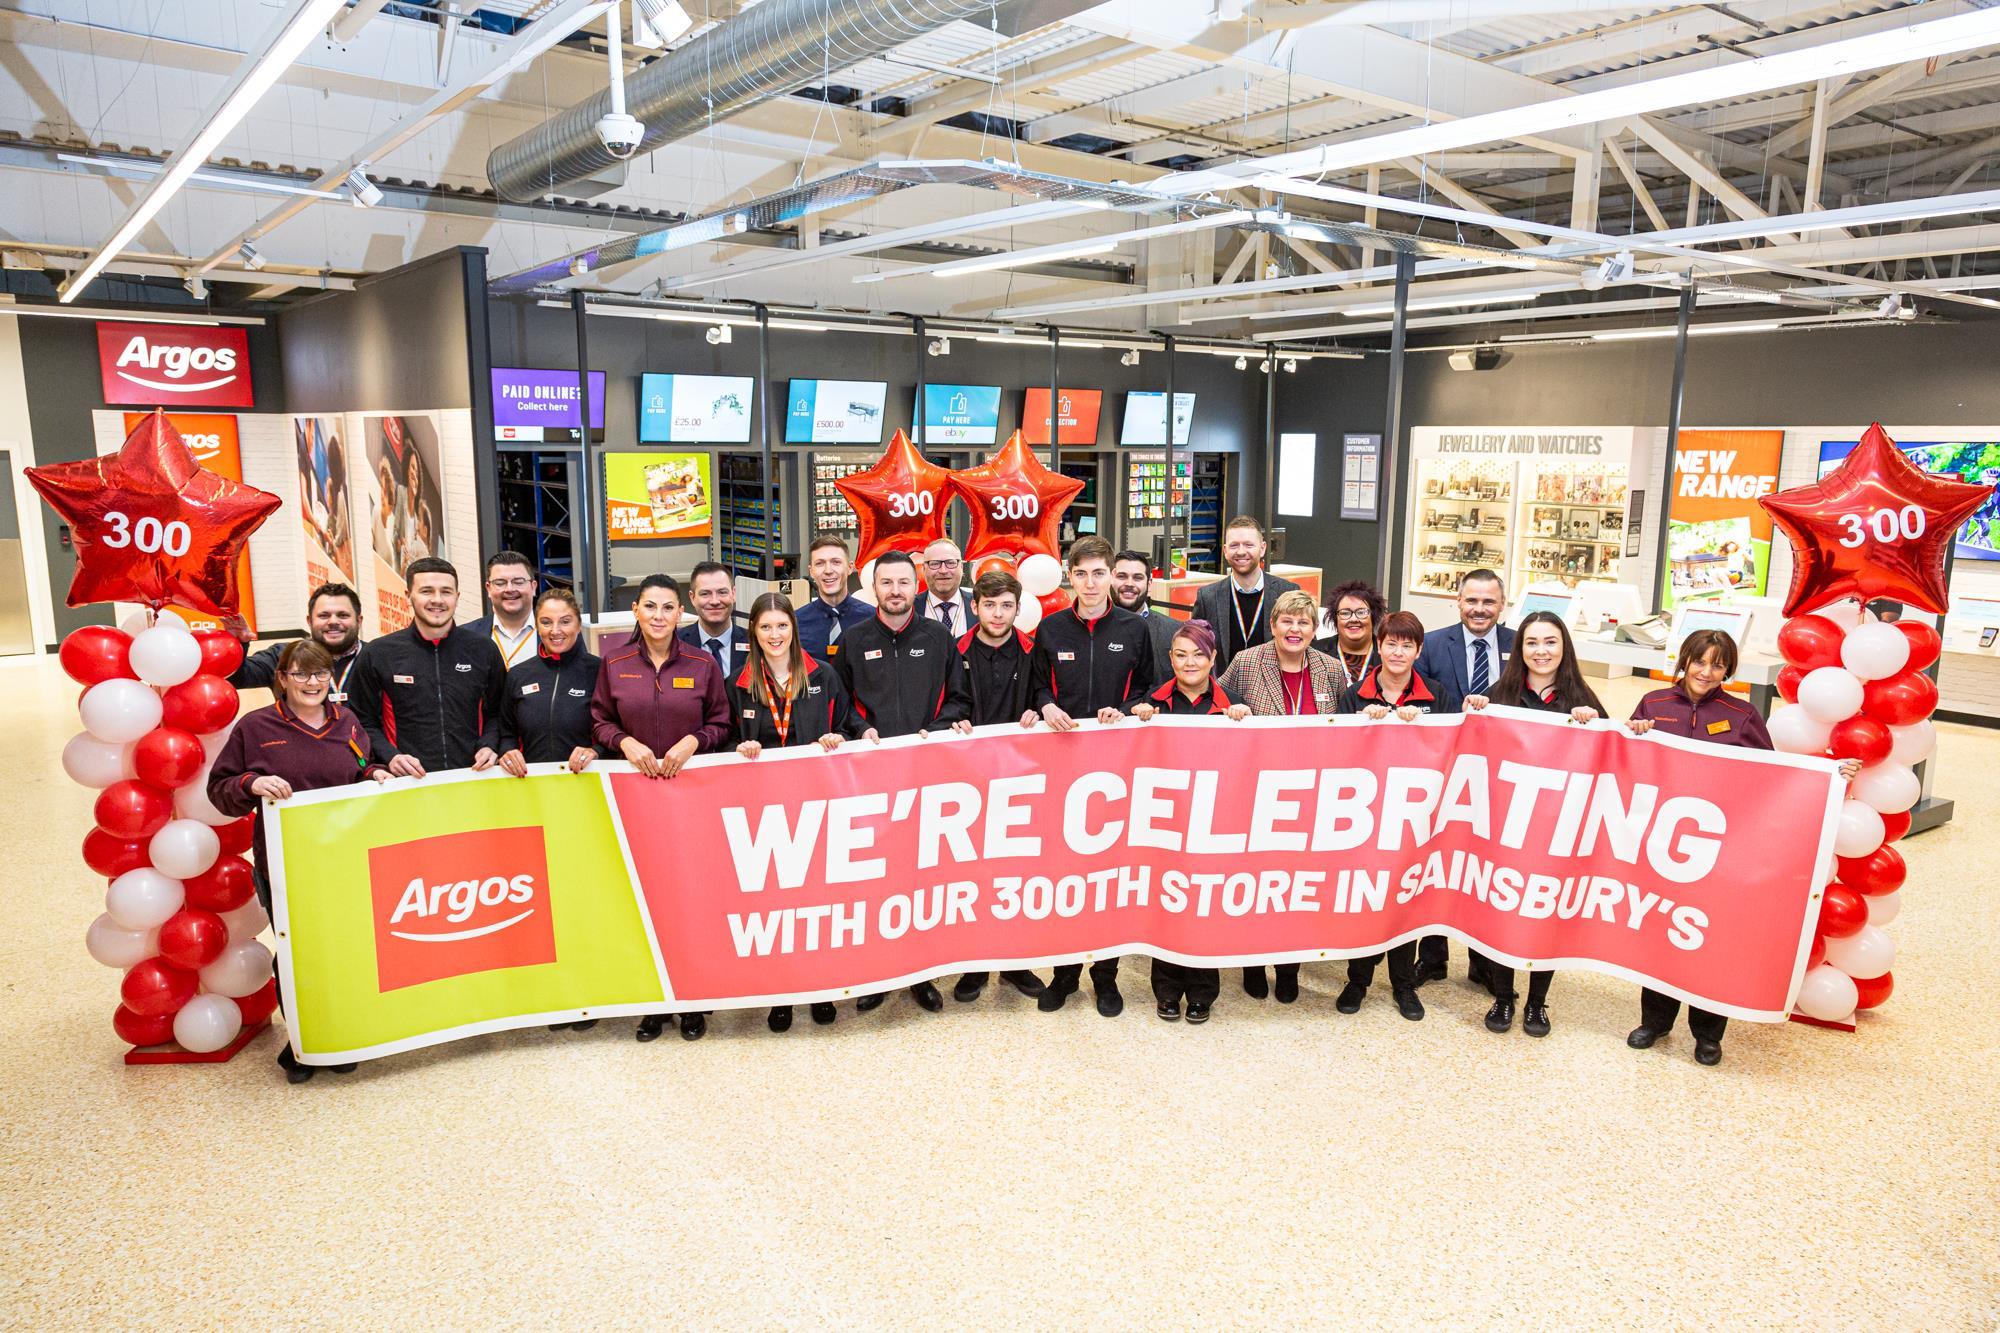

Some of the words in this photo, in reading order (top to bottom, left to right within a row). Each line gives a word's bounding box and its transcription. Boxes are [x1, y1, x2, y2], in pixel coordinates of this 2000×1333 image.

[116, 336, 236, 378] Argos
[502, 384, 530, 399] PAID
[534, 386, 581, 400] ONLINE?
[517, 401, 547, 411] Collect
[549, 403, 568, 411] here
[675, 418, 702, 426] £25.00
[942, 416, 954, 424] PAY
[945, 428, 966, 438] ebay
[1438, 434, 1506, 453] JEWELLERY
[1507, 435, 1535, 453] AND
[1538, 435, 1603, 455] WATCHES
[1674, 450, 1738, 474] NEW
[1679, 474, 1776, 499] RANGE
[887, 490, 934, 518] 300
[991, 493, 1039, 520] 300
[612, 507, 640, 518] NEW
[612, 517, 652, 528] RANGE
[1838, 505, 1926, 549] 300
[102, 511, 192, 557] 300
[638, 527, 655, 535] NOW
[910, 648, 924, 656] Argos
[1109, 642, 1123, 650] Argos
[455, 663, 471, 671] Argos
[568, 687, 586, 696] Argos
[720, 773, 1047, 893] WE'RE
[1063, 754, 1727, 883] CELEBRATING
[390, 874, 534, 923] Argos
[727, 901, 867, 958] WITH
[878, 881, 979, 940] OUR
[990, 866, 1152, 921] 300TH
[1160, 870, 1326, 917] STORE
[1335, 870, 1390, 914] IN
[1396, 850, 1709, 951] SAINSBURY'S
